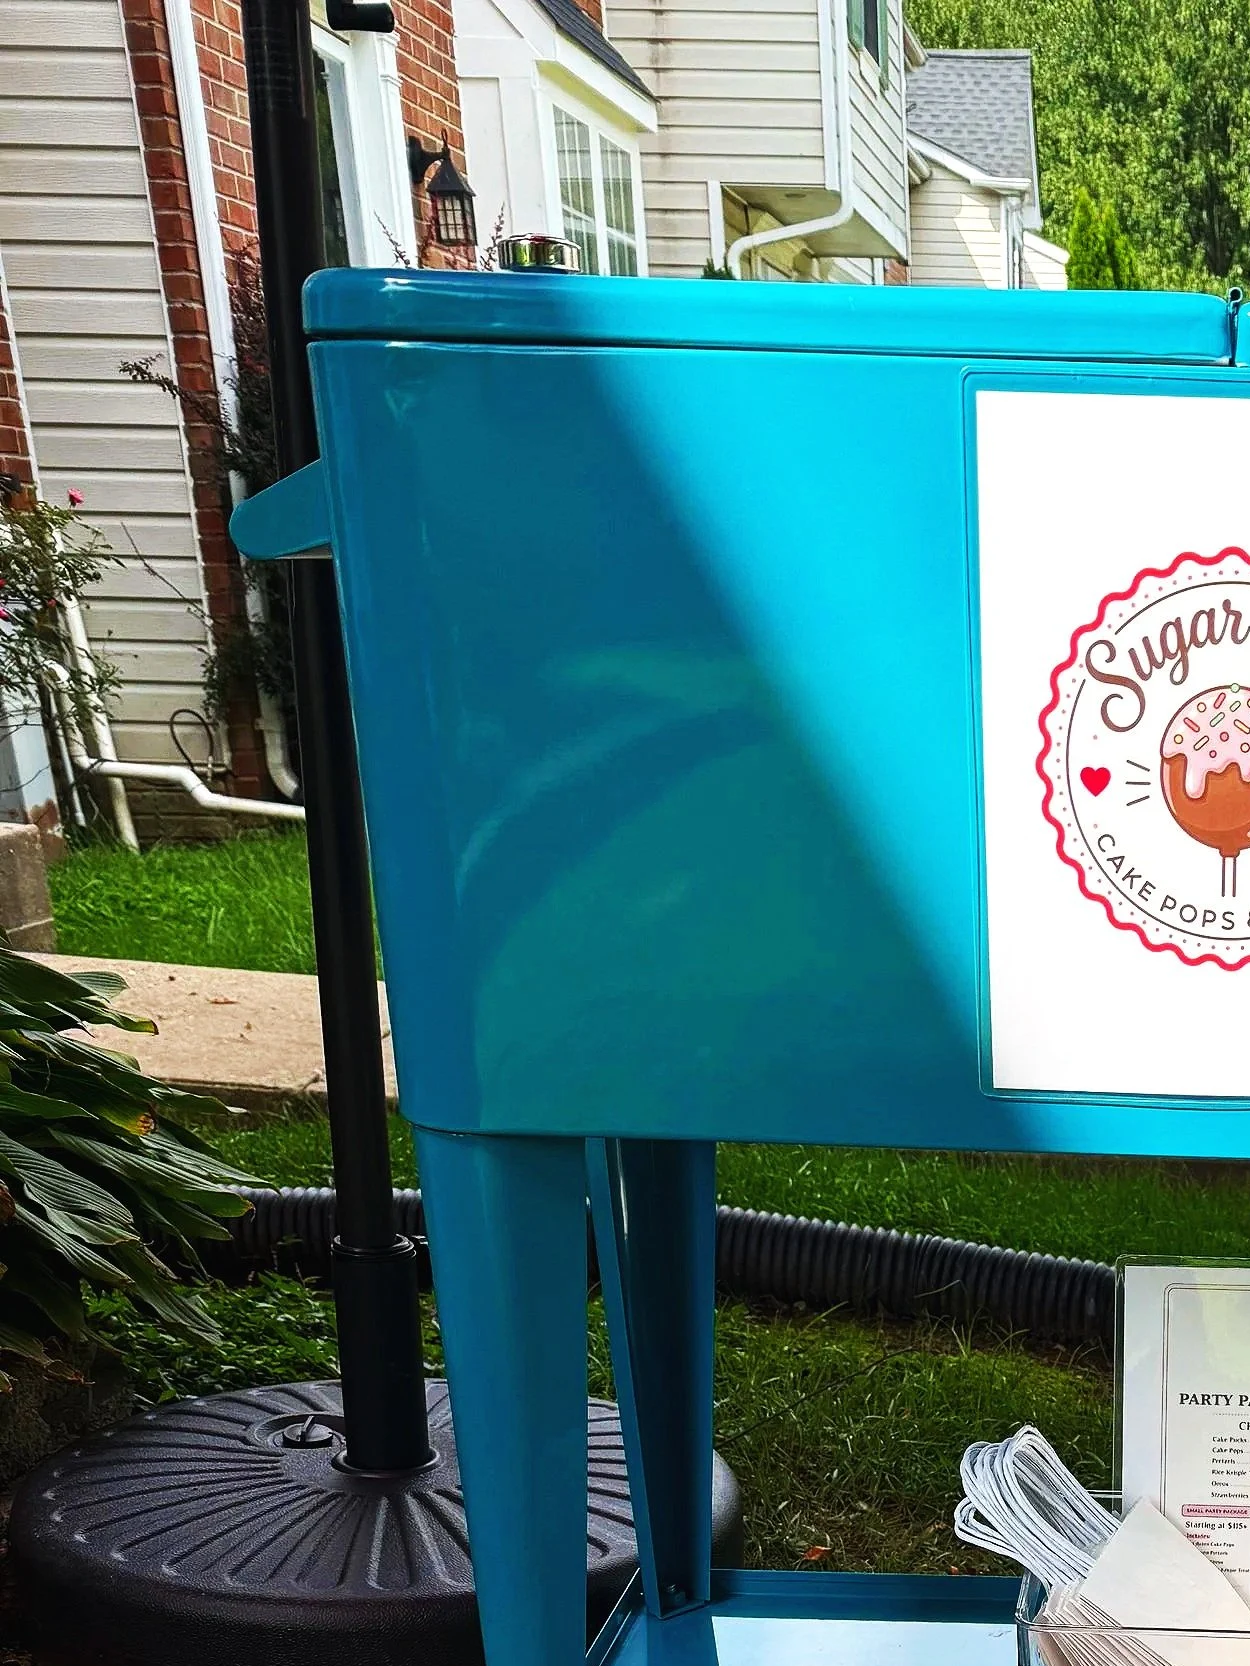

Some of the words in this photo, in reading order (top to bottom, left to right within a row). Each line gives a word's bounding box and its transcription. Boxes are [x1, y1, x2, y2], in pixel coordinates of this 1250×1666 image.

[1096, 832, 1154, 903] CAKE
[1159, 893, 1236, 931] POPS
[1179, 1393, 1234, 1406] PARTY
[1185, 1521, 1216, 1530] Starting
